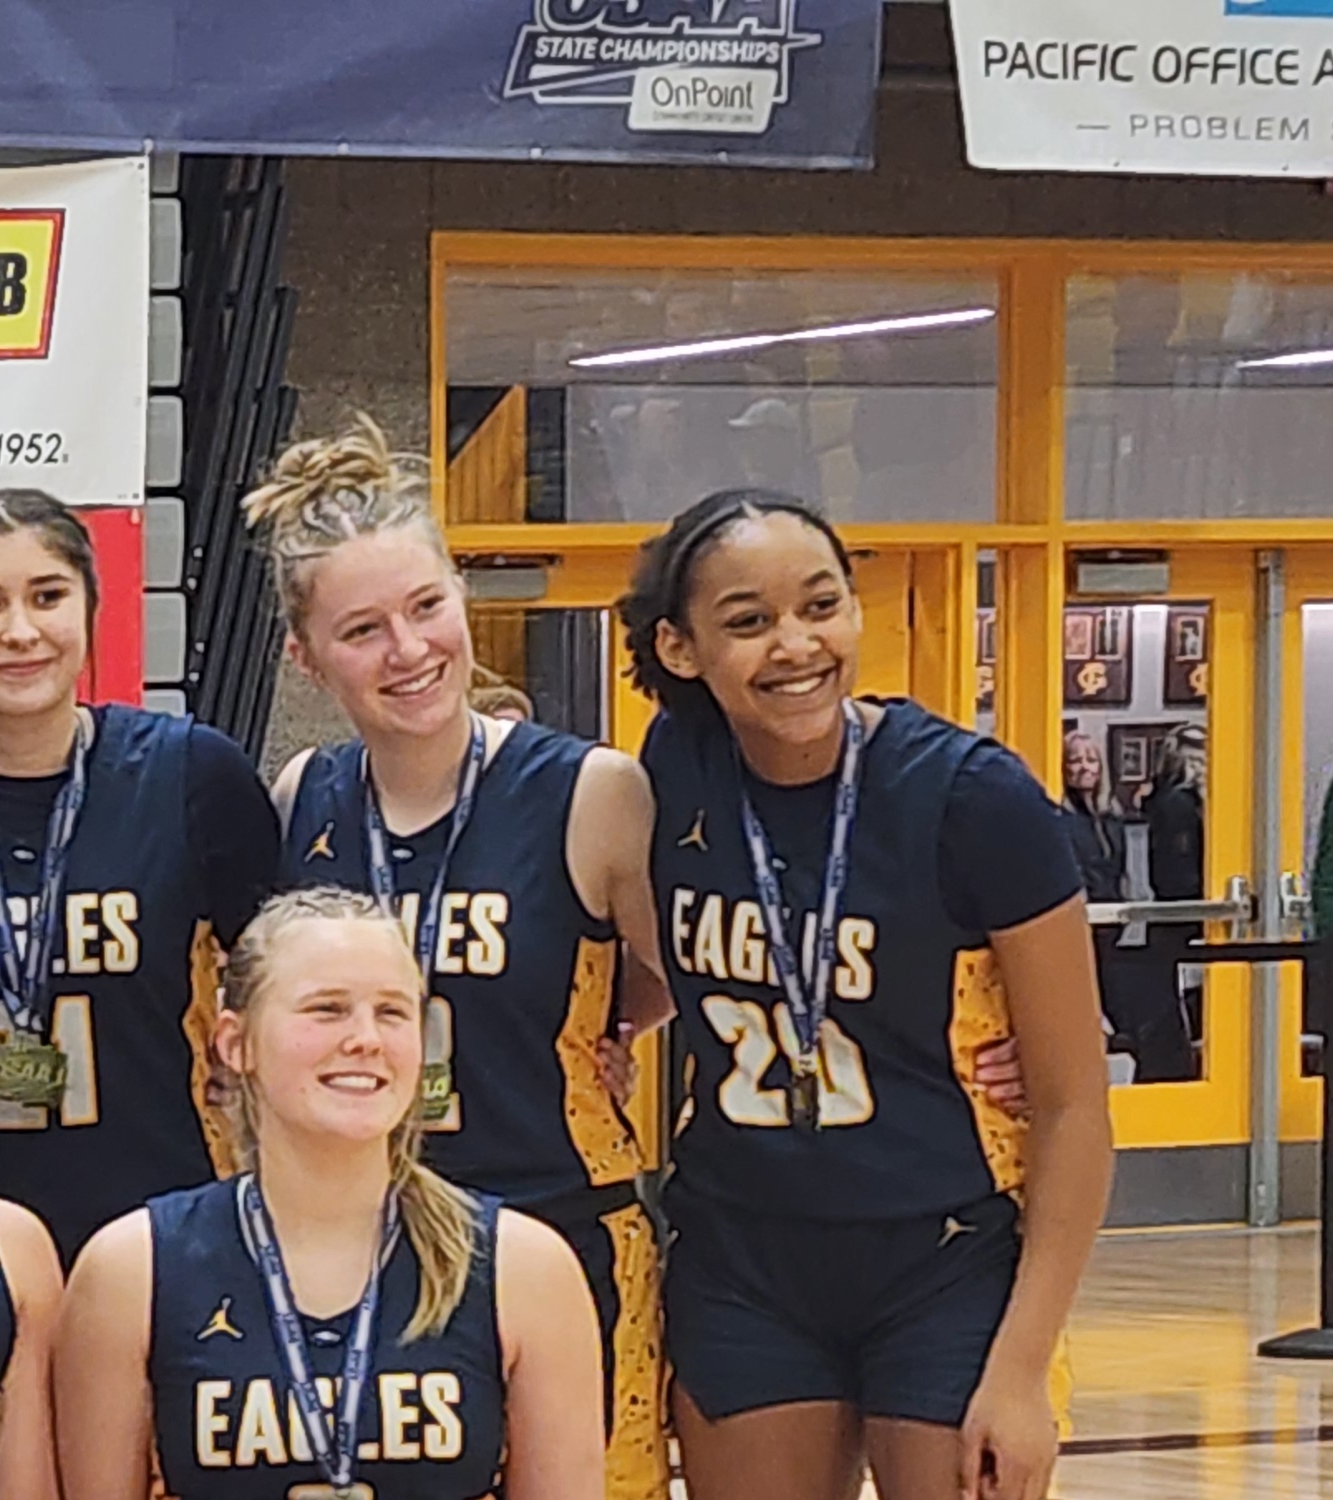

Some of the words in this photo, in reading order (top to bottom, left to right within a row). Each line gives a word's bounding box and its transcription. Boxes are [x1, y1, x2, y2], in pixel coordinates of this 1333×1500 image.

[535, 36, 598, 60] STATE
[600, 37, 780, 64] CHAMPIONSHIPS
[983, 40, 1138, 83] PACIFIC
[1152, 46, 1300, 86] OFFICE
[651, 77, 755, 110] OnPoint
[1128, 114, 1310, 141] PROBLEM
[672, 887, 875, 1001] EAGS
[196, 1372, 463, 1466] EAGES
